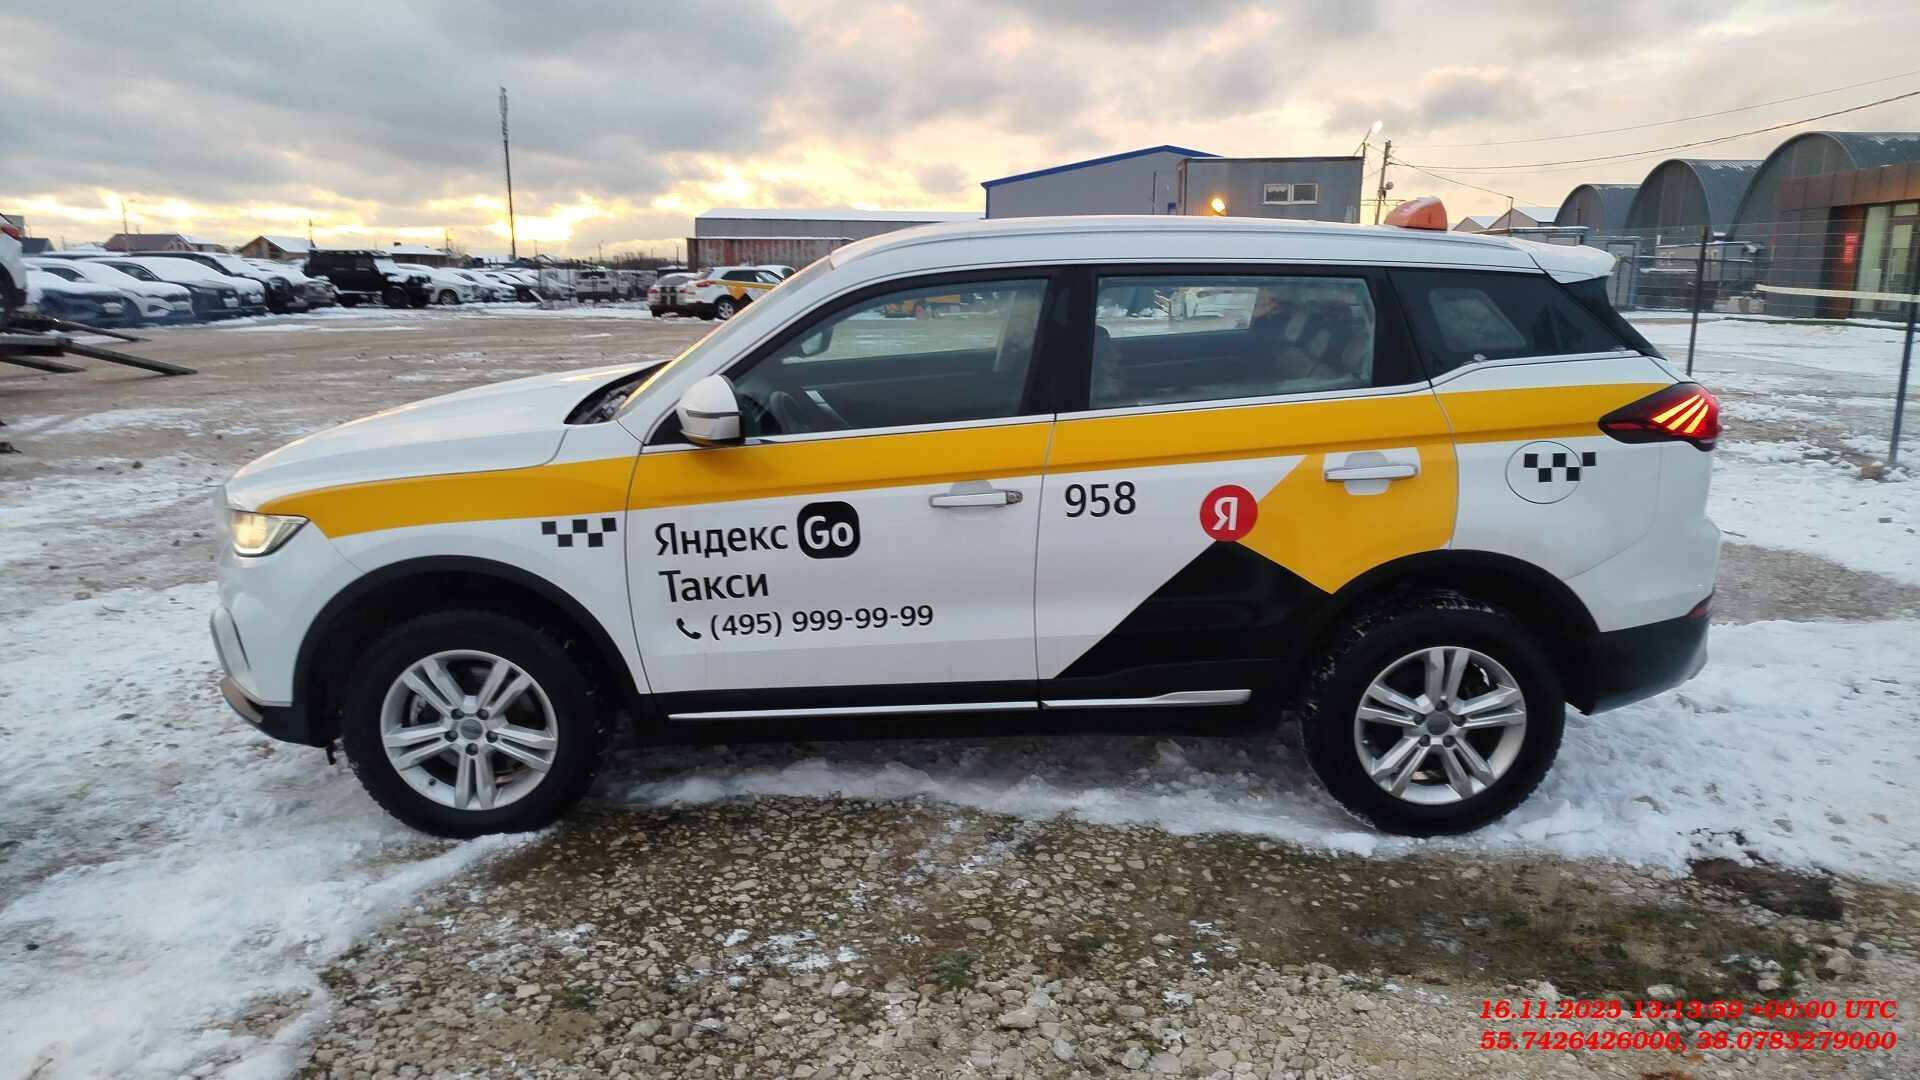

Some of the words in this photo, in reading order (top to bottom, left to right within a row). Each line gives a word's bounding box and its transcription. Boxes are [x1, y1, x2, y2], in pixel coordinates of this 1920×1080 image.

[1065, 481, 1136, 518] 958
[1212, 497, 1239, 531] Я
[655, 523, 788, 559] Яндекс
[802, 514, 855, 550] Go
[658, 570, 769, 603] Такси
[710, 611, 782, 640] (495)
[792, 605, 934, 633] 999-99-99
